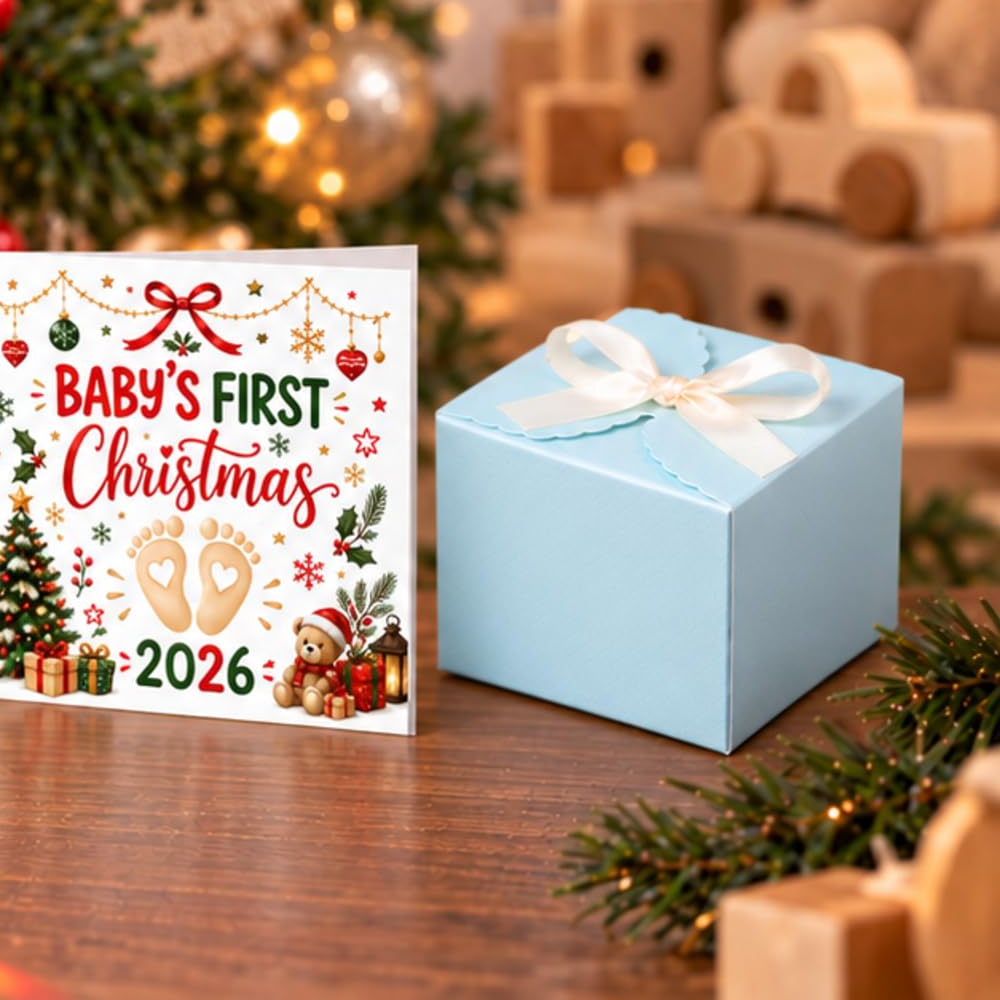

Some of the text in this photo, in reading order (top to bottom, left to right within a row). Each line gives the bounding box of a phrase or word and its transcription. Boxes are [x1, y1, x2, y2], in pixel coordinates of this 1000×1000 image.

[55, 359, 330, 429] BABY'S FIRST
[62, 424, 340, 528] Christmas
[136, 638, 255, 695] 2026
